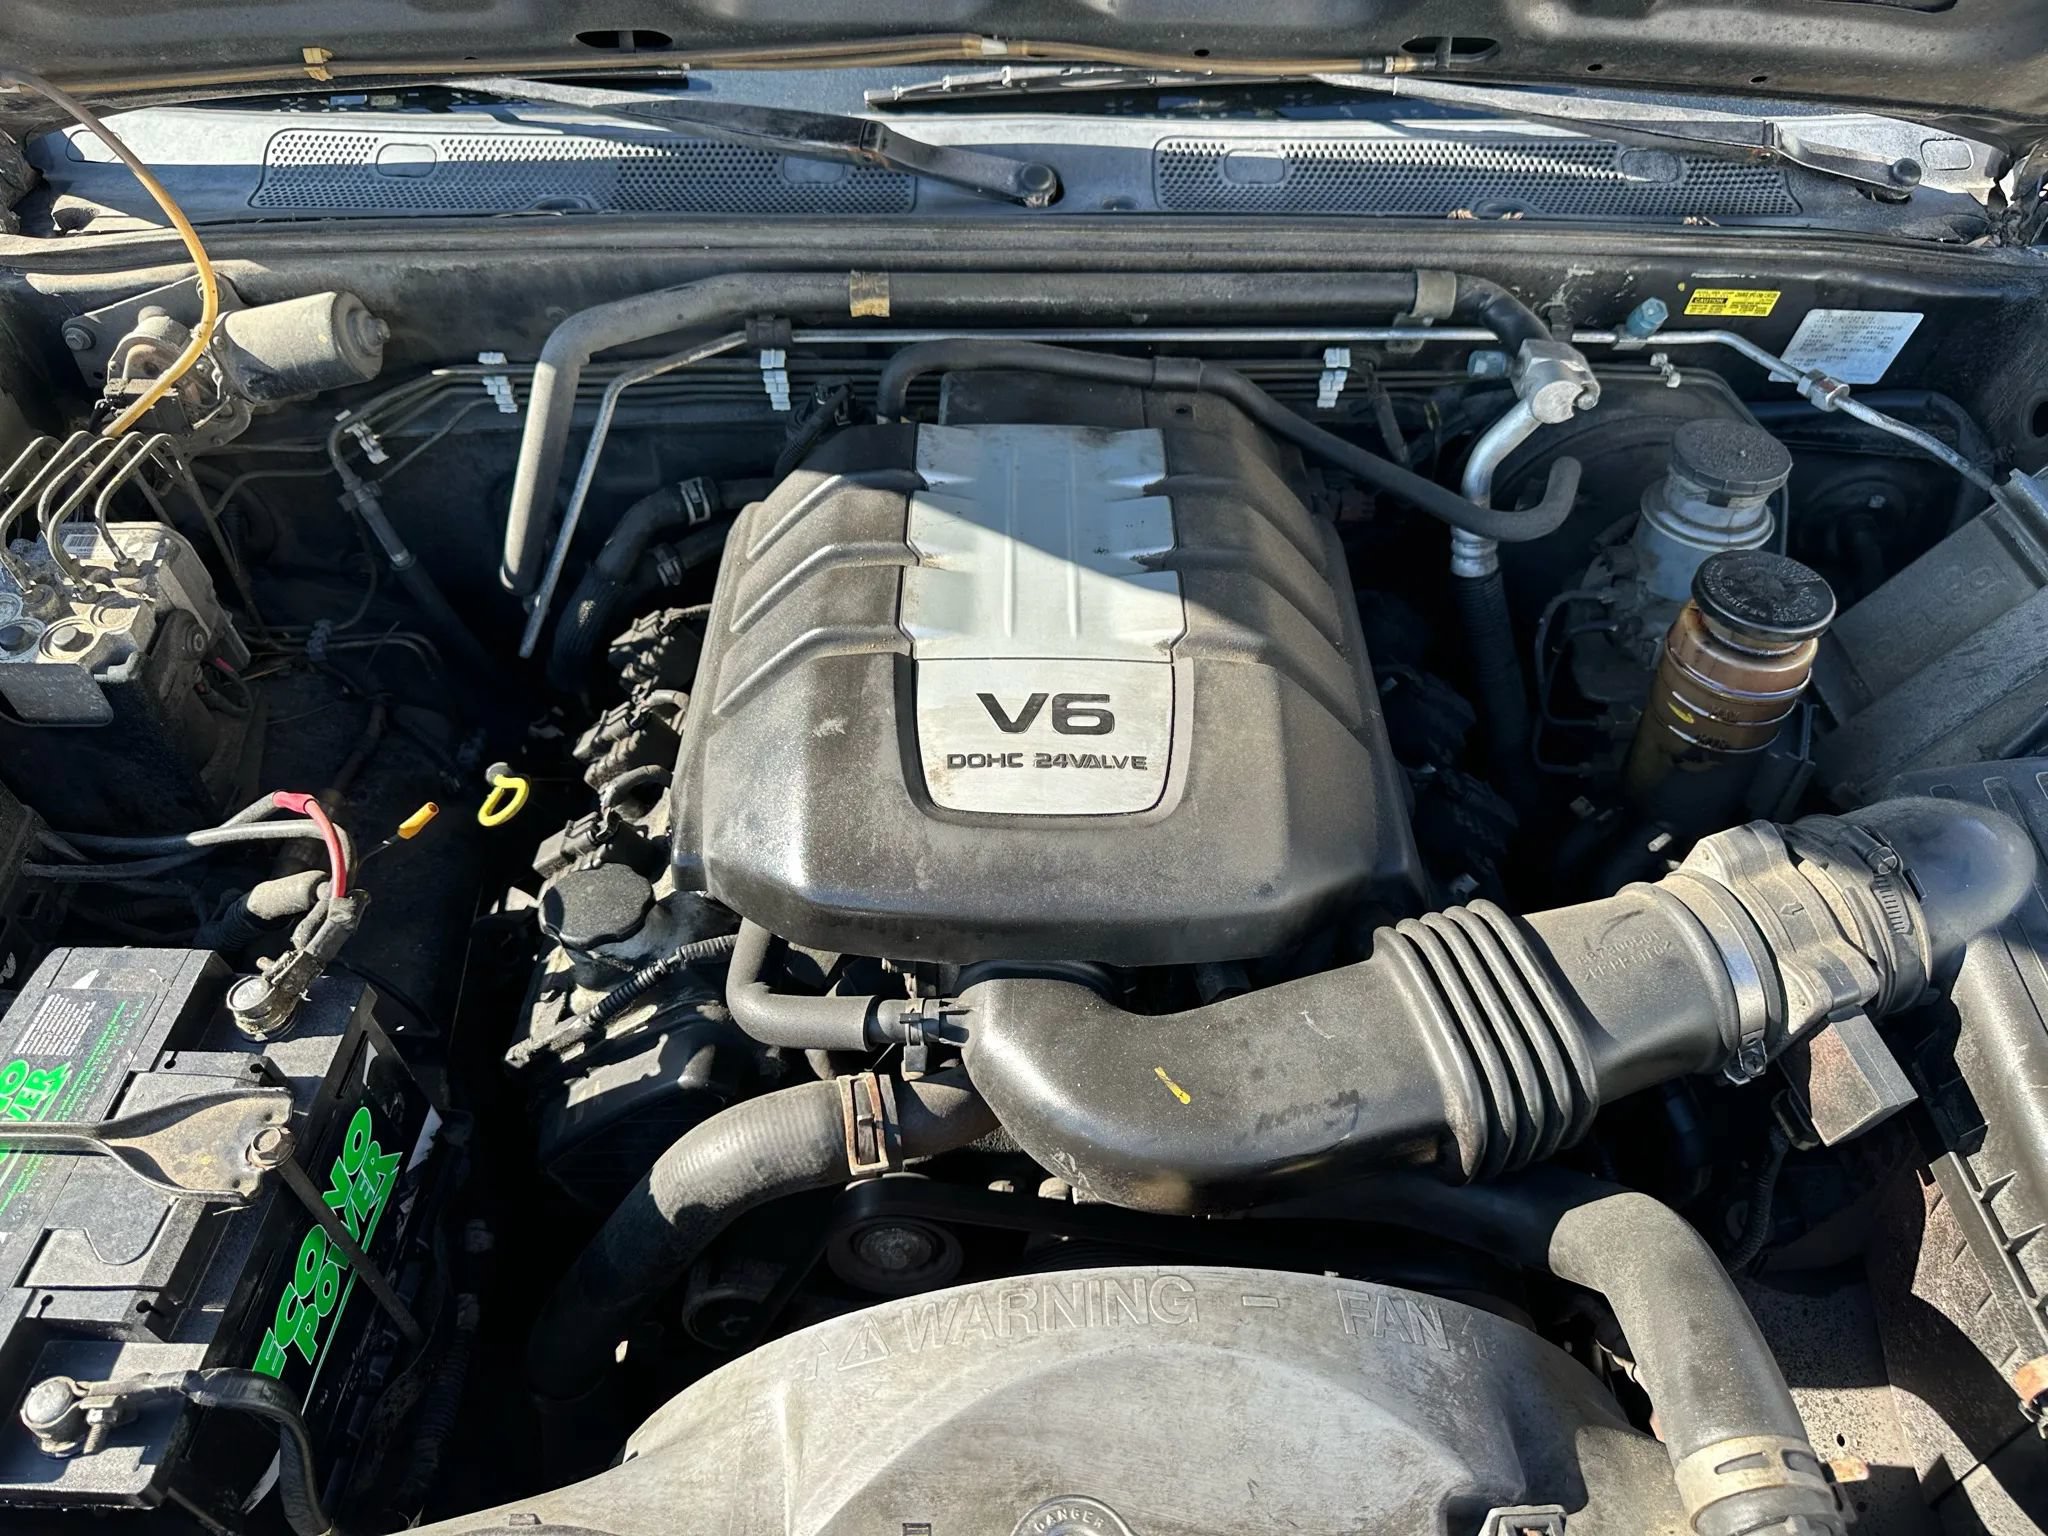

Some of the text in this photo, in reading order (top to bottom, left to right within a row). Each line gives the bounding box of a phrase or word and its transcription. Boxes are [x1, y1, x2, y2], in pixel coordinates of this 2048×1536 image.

[976, 693, 1115, 735] V6
[947, 752, 1148, 771] DOHC 24VALVE
[902, 1274, 1199, 1354] WARNING
[1336, 1289, 1450, 1351] FAN
[1032, 1507, 1105, 1533] DANGER
